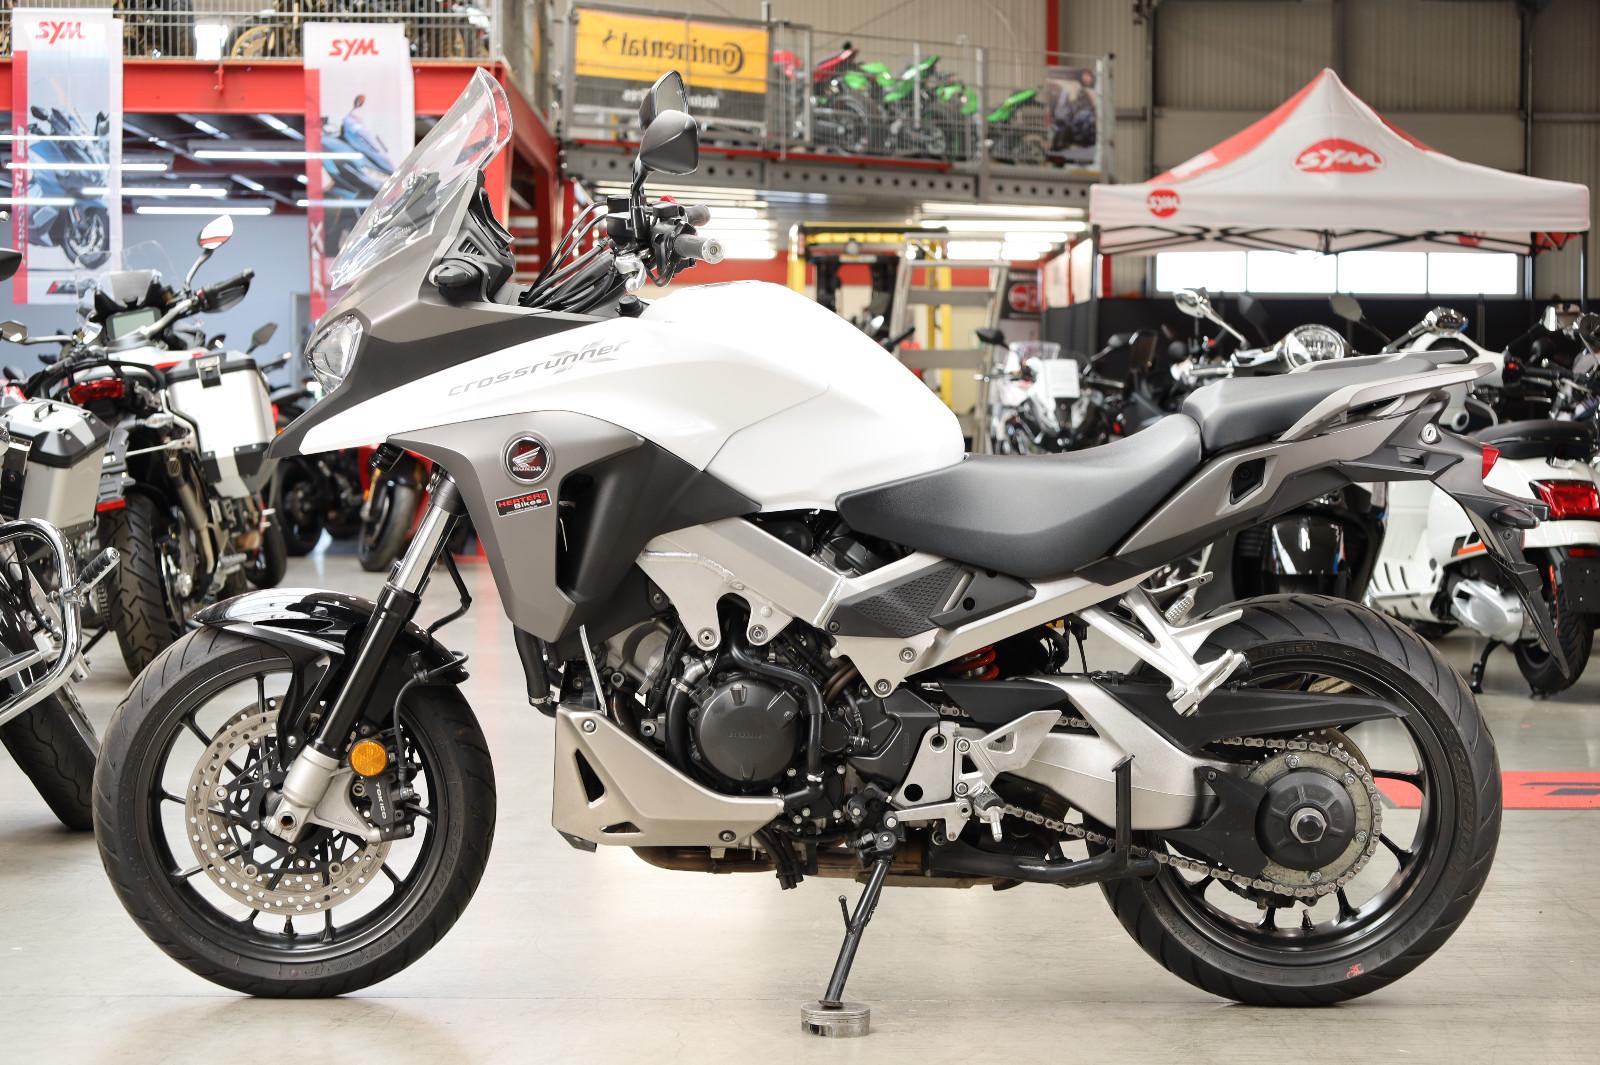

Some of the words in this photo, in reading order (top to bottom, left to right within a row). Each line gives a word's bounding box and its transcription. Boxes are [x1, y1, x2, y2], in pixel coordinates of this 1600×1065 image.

[35, 20, 86, 45] SYM
[329, 37, 379, 62] SYM
[1298, 148, 1378, 168] SYM
[447, 339, 631, 397] crossrunner
[513, 499, 542, 510] Bikes
[375, 781, 387, 820] TOKICO
